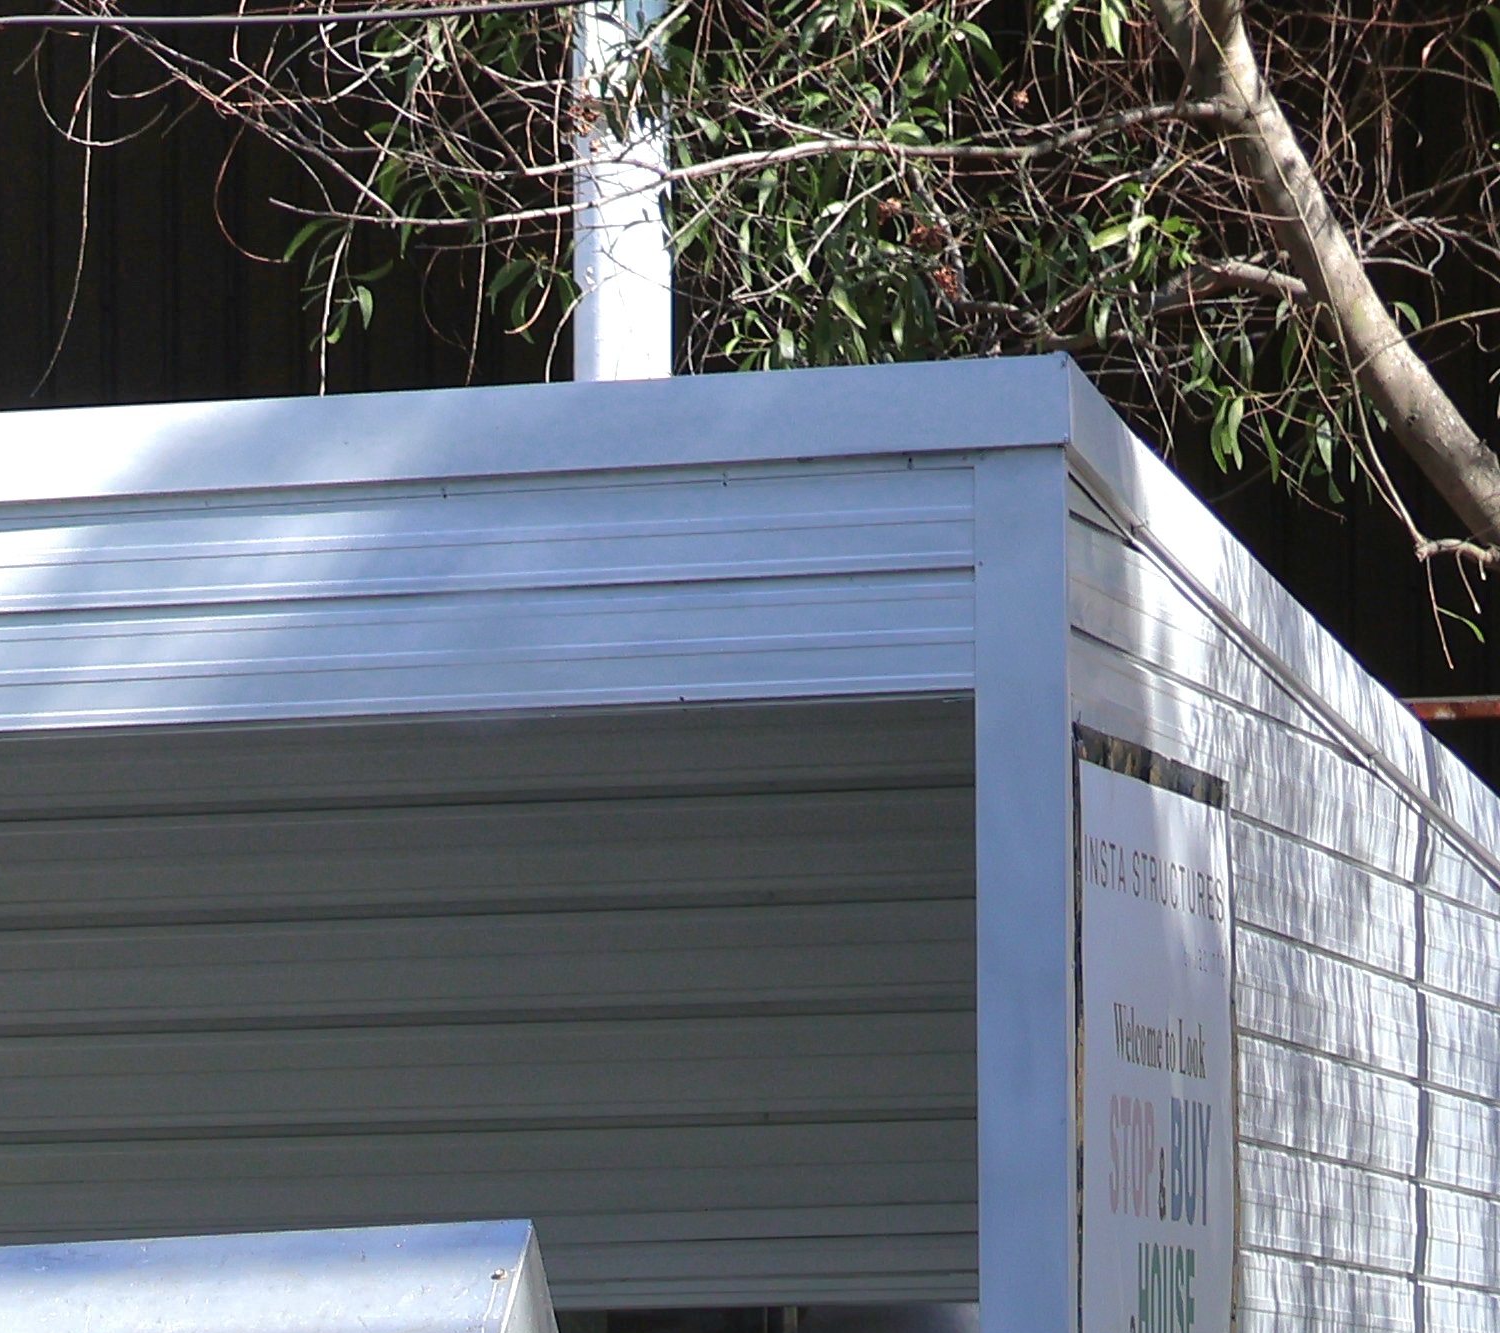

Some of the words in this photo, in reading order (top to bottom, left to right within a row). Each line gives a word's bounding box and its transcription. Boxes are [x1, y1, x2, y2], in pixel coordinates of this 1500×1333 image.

[1085, 834, 1126, 893] INSTA
[1132, 850, 1225, 924] STRUCTURES
[1113, 1002, 1163, 1071] Welcome
[1165, 1022, 1176, 1073] to
[1178, 1018, 1206, 1079] Look
[1109, 1094, 1154, 1217] STOP
[1171, 1096, 1211, 1226] BUY
